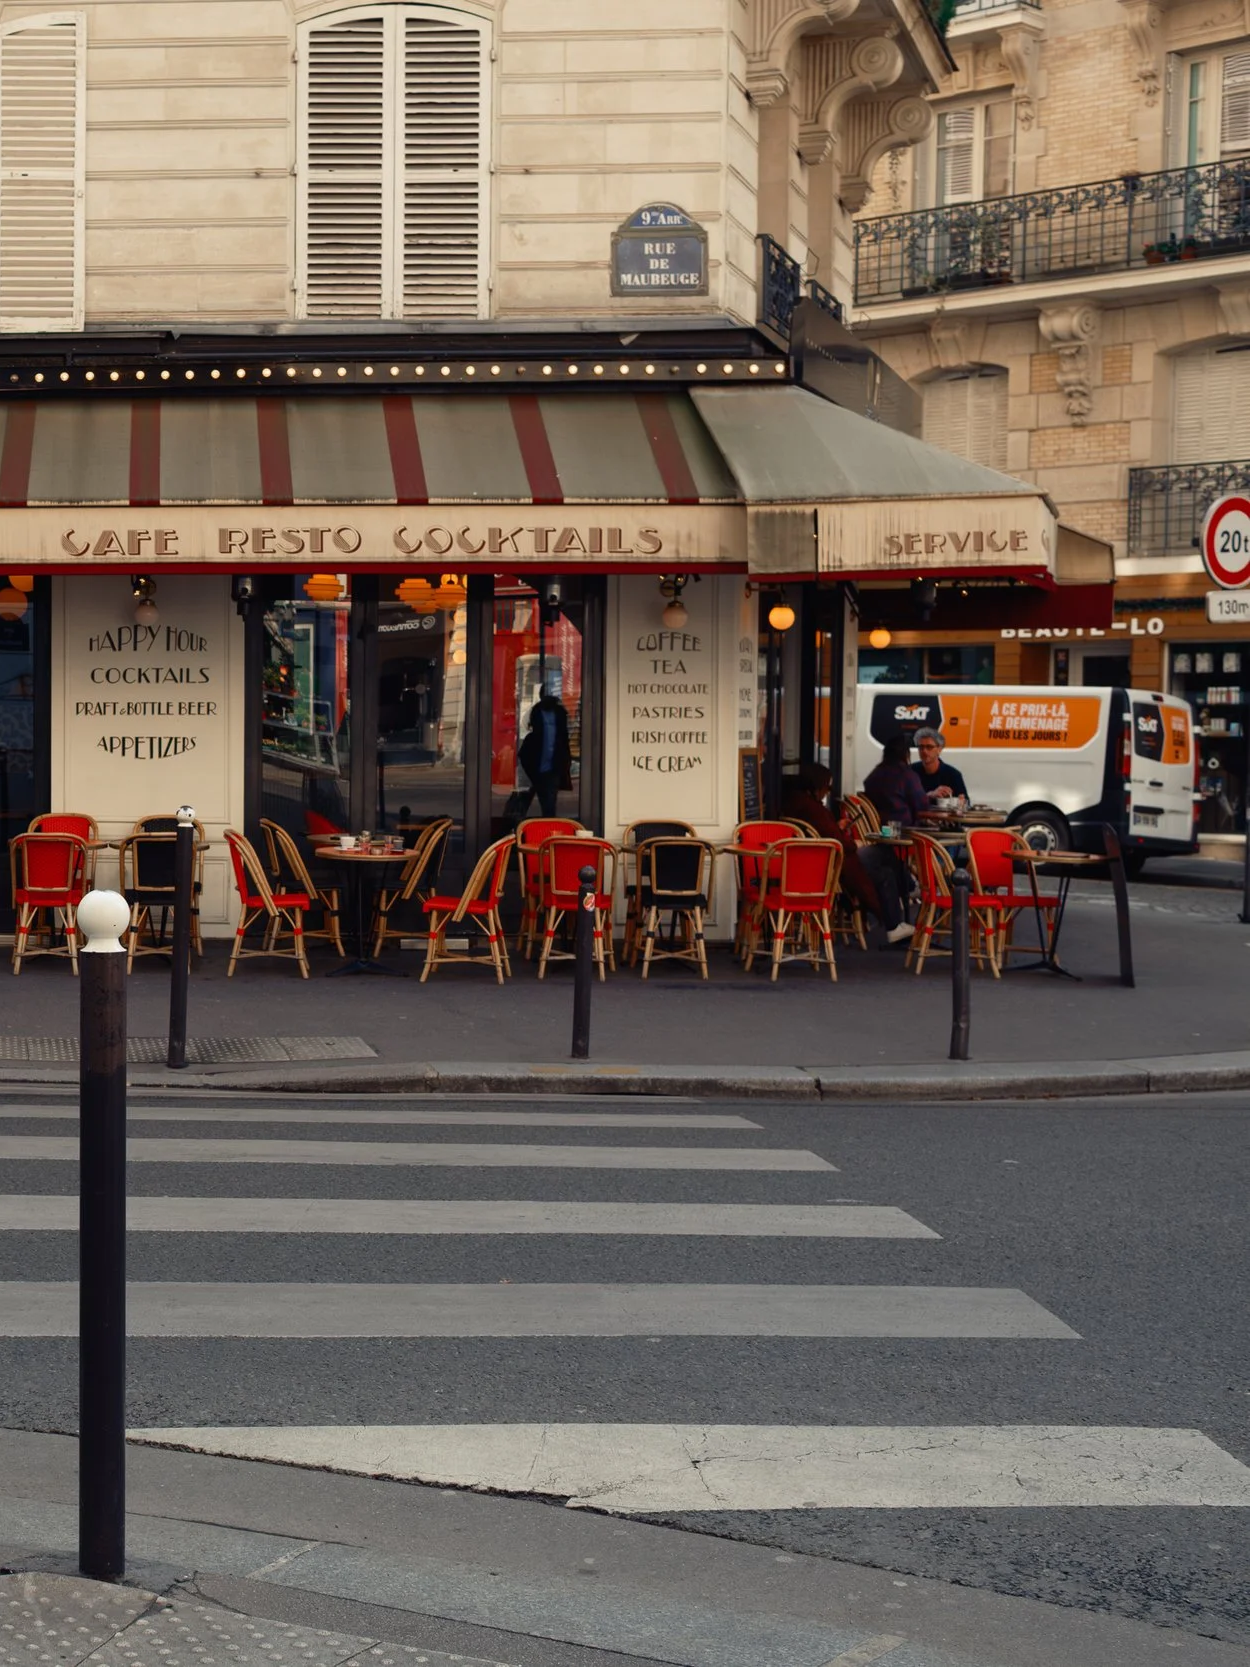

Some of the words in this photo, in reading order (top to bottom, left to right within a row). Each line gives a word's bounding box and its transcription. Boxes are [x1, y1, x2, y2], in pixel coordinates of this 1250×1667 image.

[644, 242, 676, 255] RUE
[649, 258, 669, 270] DE
[620, 272, 700, 286] MAUBEUGE
[61, 527, 179, 556] CAFE
[218, 524, 362, 555] RESTO
[392, 524, 662, 555] COCKTAILS
[884, 530, 1028, 556] SERVICE
[89, 624, 161, 651] HAPPY
[166, 626, 208, 652] HOUR
[636, 631, 702, 652] COFFEE
[650, 659, 687, 675] TEA
[90, 667, 210, 684] COCKTAILS
[628, 684, 647, 694] HOT
[650, 684, 709, 695] CHOCOLATE
[75, 702, 119, 716] DRAFT
[127, 702, 174, 716] BOTTLE
[178, 702, 217, 716] BEER
[632, 706, 704, 719] PASTRIES
[1002, 703, 1017, 716] CE
[631, 731, 666, 744] IRISH
[668, 731, 708, 744] COFFEE
[988, 729, 1010, 740] TOUS
[1013, 730, 1029, 740] LES
[1031, 730, 1061, 741] JOURS
[97, 736, 197, 760] APPETIZERS
[633, 756, 653, 772] ICE
[657, 756, 702, 773] CREAM
